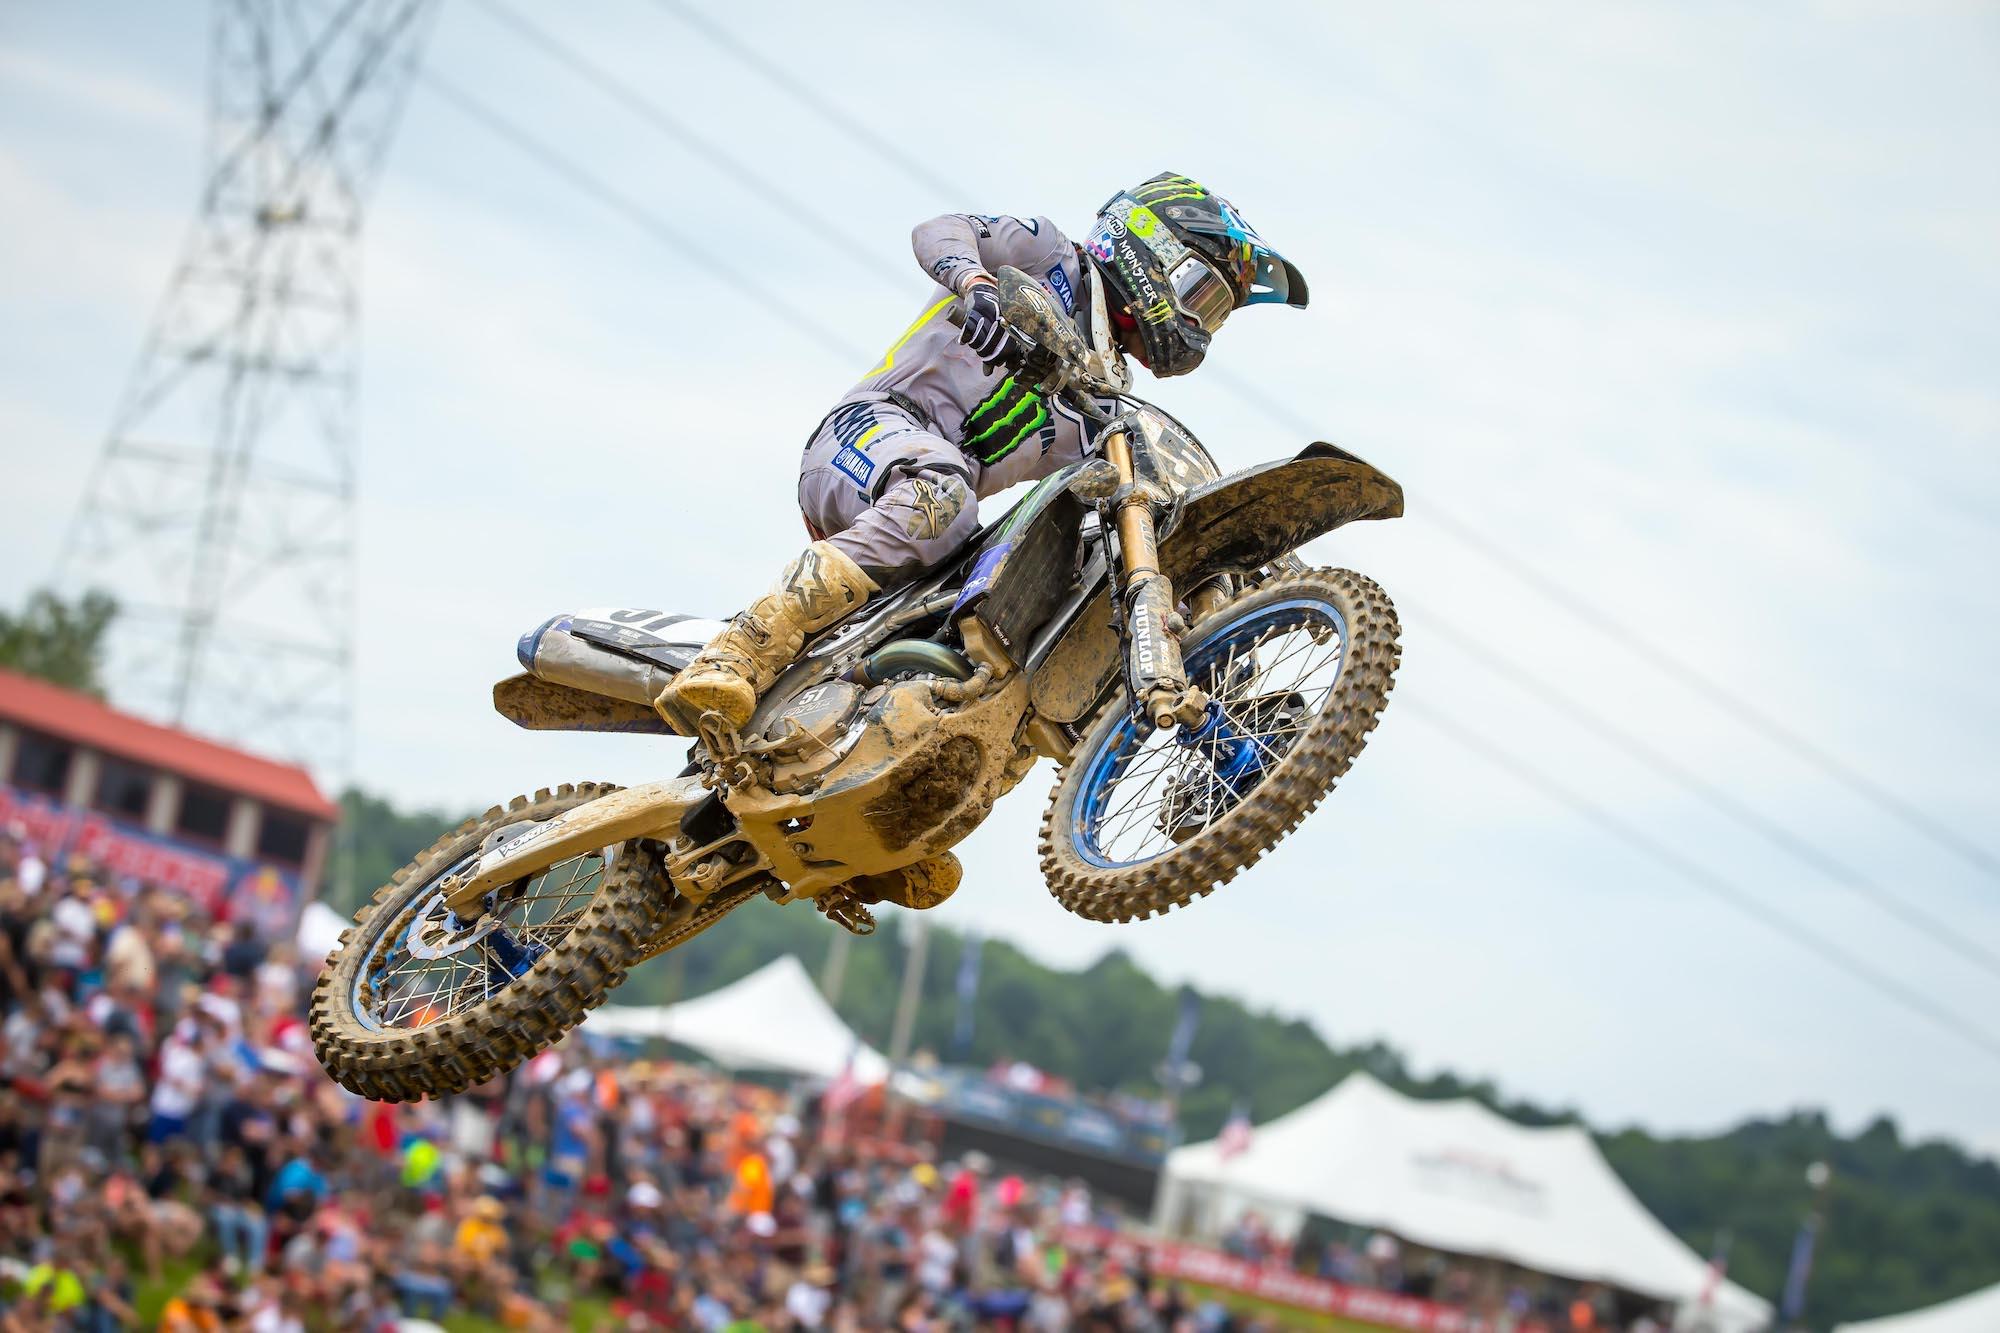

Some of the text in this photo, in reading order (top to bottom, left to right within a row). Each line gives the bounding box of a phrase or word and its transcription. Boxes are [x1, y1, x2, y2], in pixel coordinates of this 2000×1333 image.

[1115, 255, 1141, 297] ENERGY
[1060, 282, 1073, 312] YAM
[841, 450, 871, 483] YAMAHA
[1134, 603, 1154, 674] DUNLOP
[799, 686, 828, 705] 51
